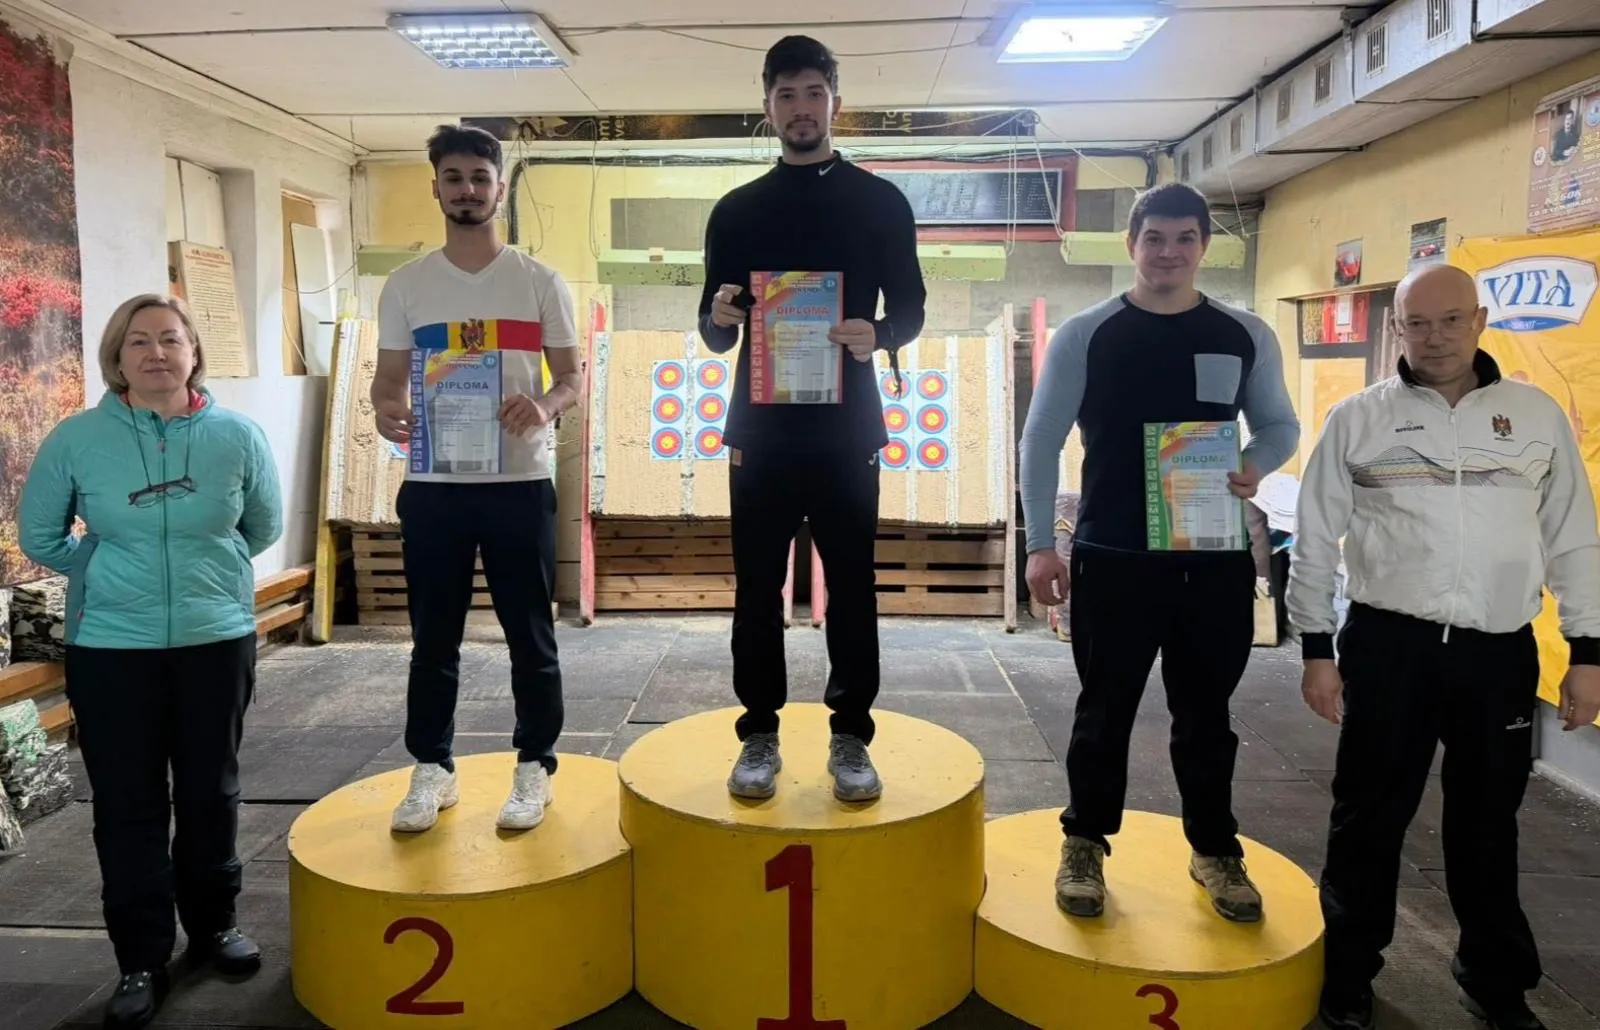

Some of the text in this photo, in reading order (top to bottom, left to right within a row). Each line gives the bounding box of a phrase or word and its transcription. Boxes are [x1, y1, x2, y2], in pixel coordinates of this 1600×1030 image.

[1483, 269, 1575, 308] VITA
[776, 305, 830, 316] DIPLOMA
[436, 381, 489, 390] DIPLOMA
[1171, 454, 1228, 465] DIPLOMA
[757, 844, 847, 1030] 1
[383, 916, 464, 1015] 2
[1135, 983, 1180, 1030] 3
